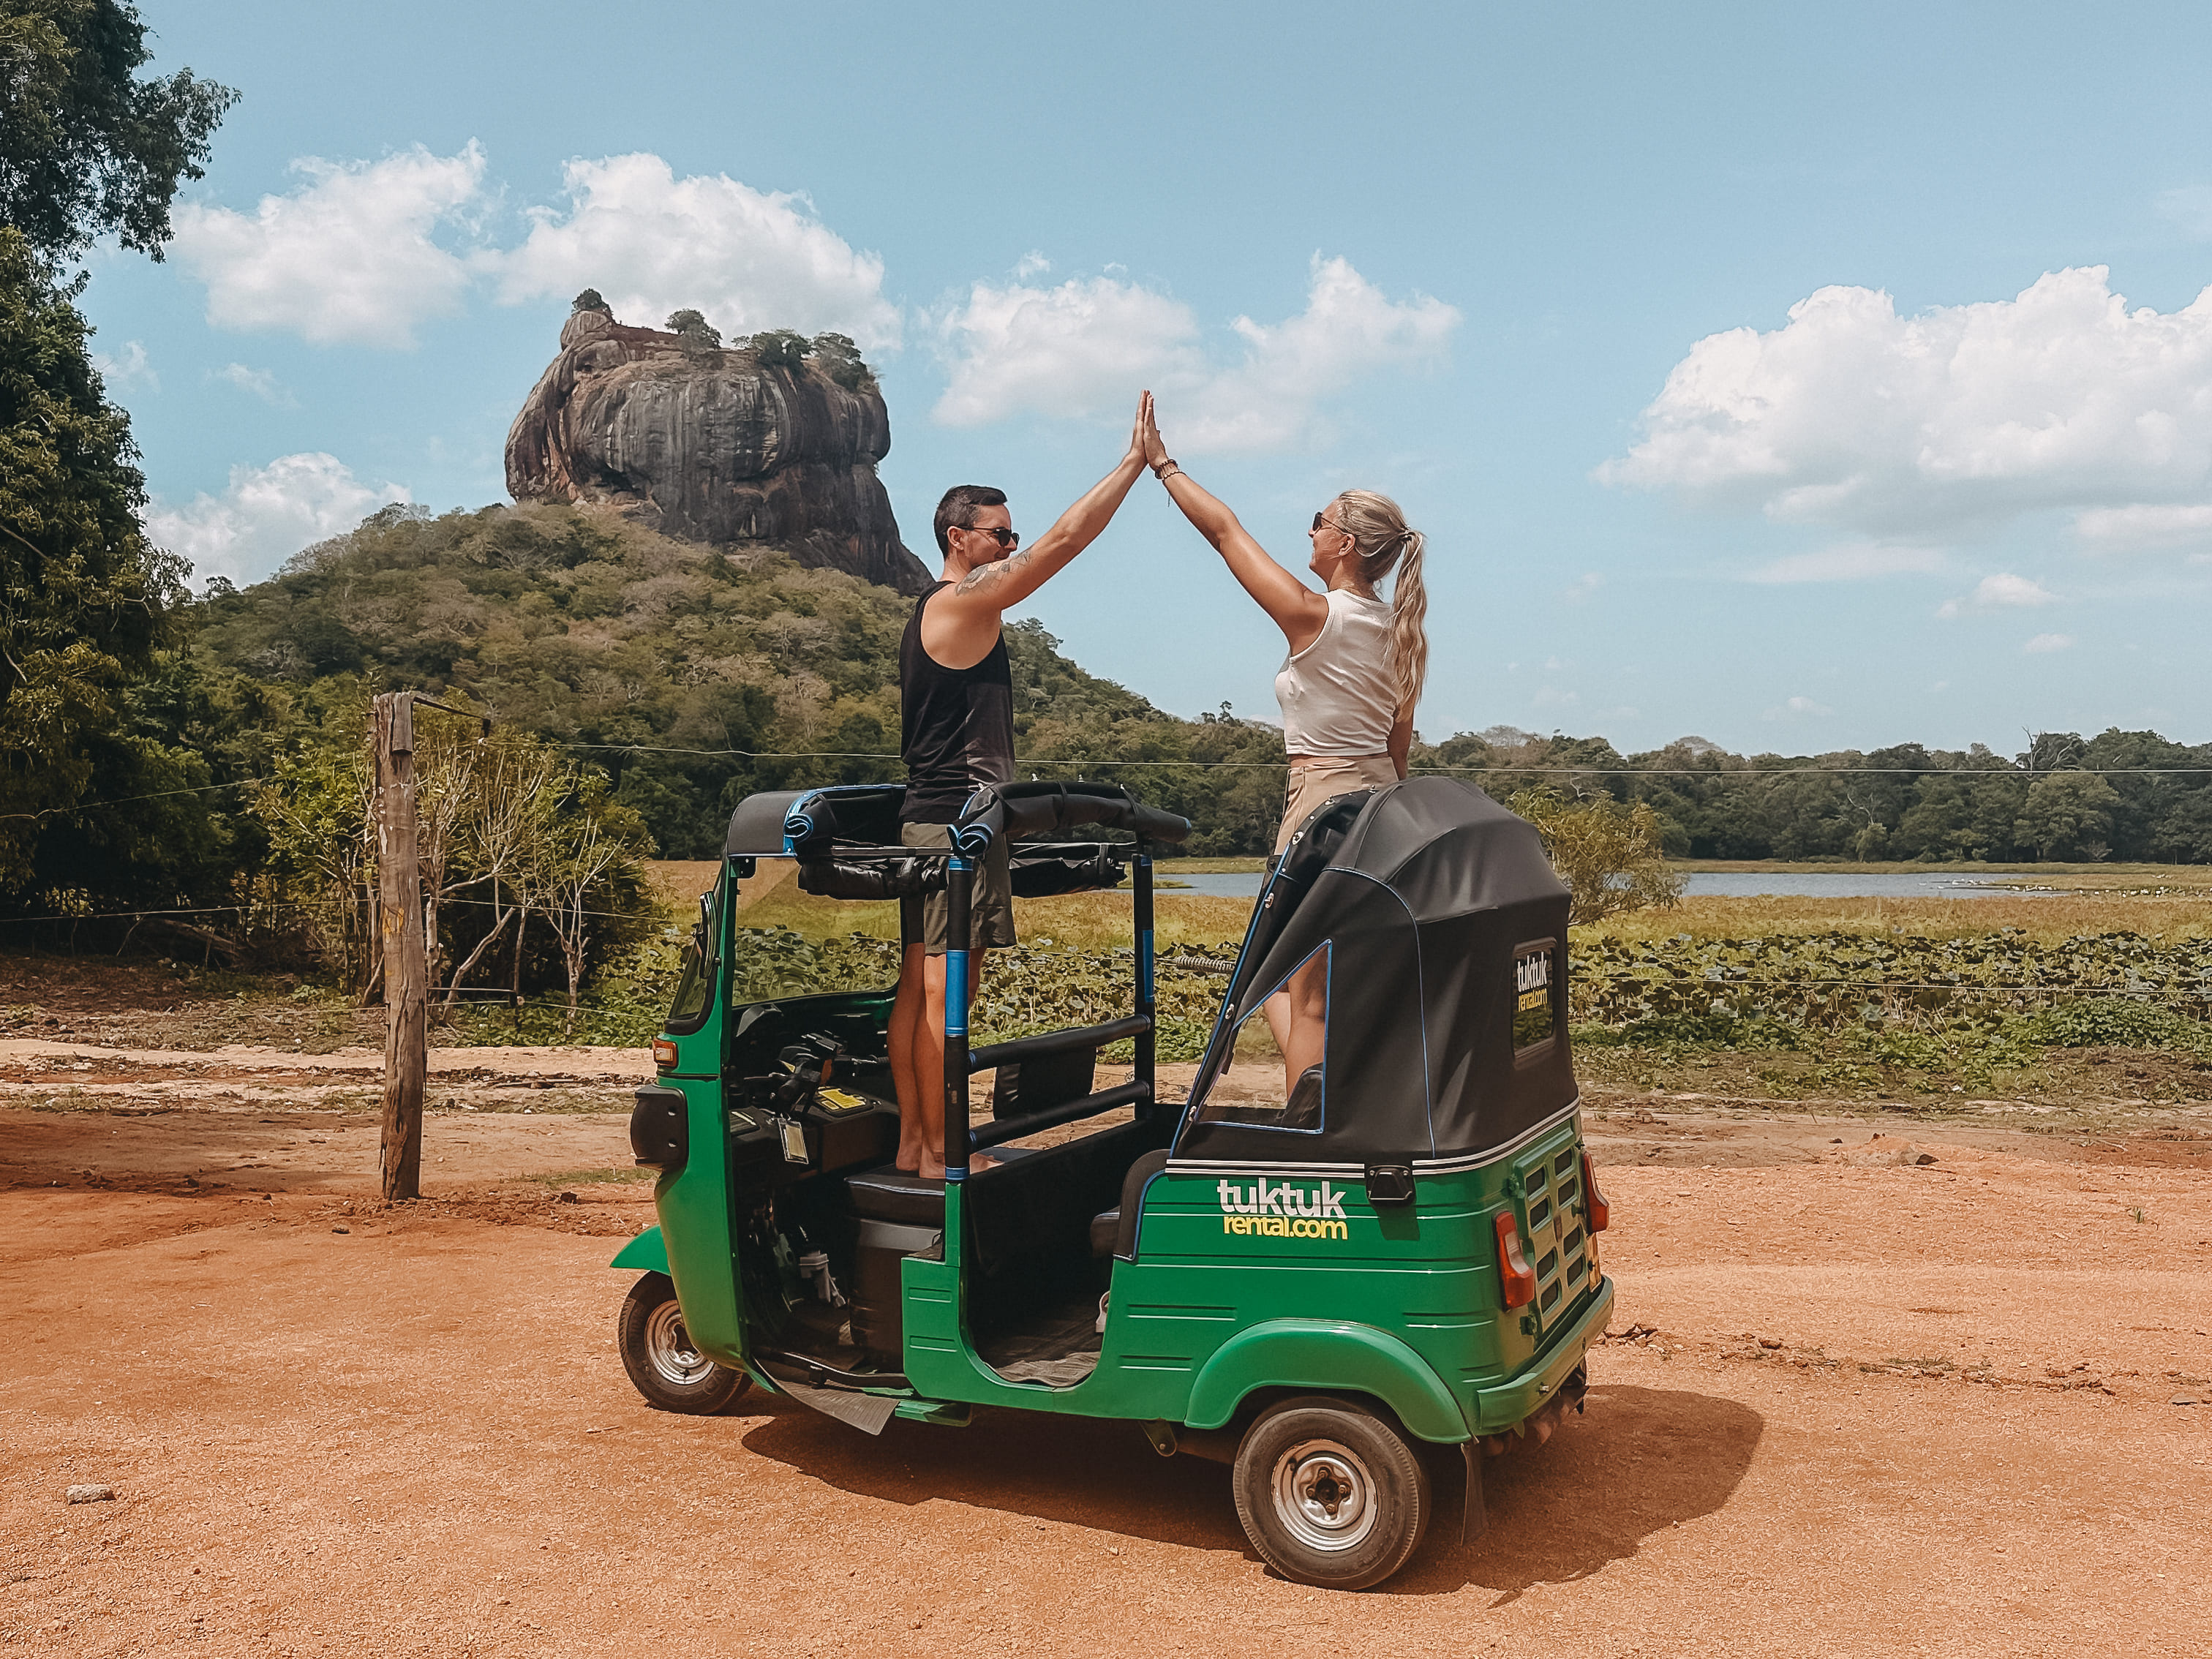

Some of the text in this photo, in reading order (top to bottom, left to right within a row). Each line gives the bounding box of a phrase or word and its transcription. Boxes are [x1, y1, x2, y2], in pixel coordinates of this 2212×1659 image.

[1517, 952, 1547, 992] tuktuk
[1216, 1177, 1347, 1219] tuktuk
[1224, 1216, 1348, 1240] rental.com
